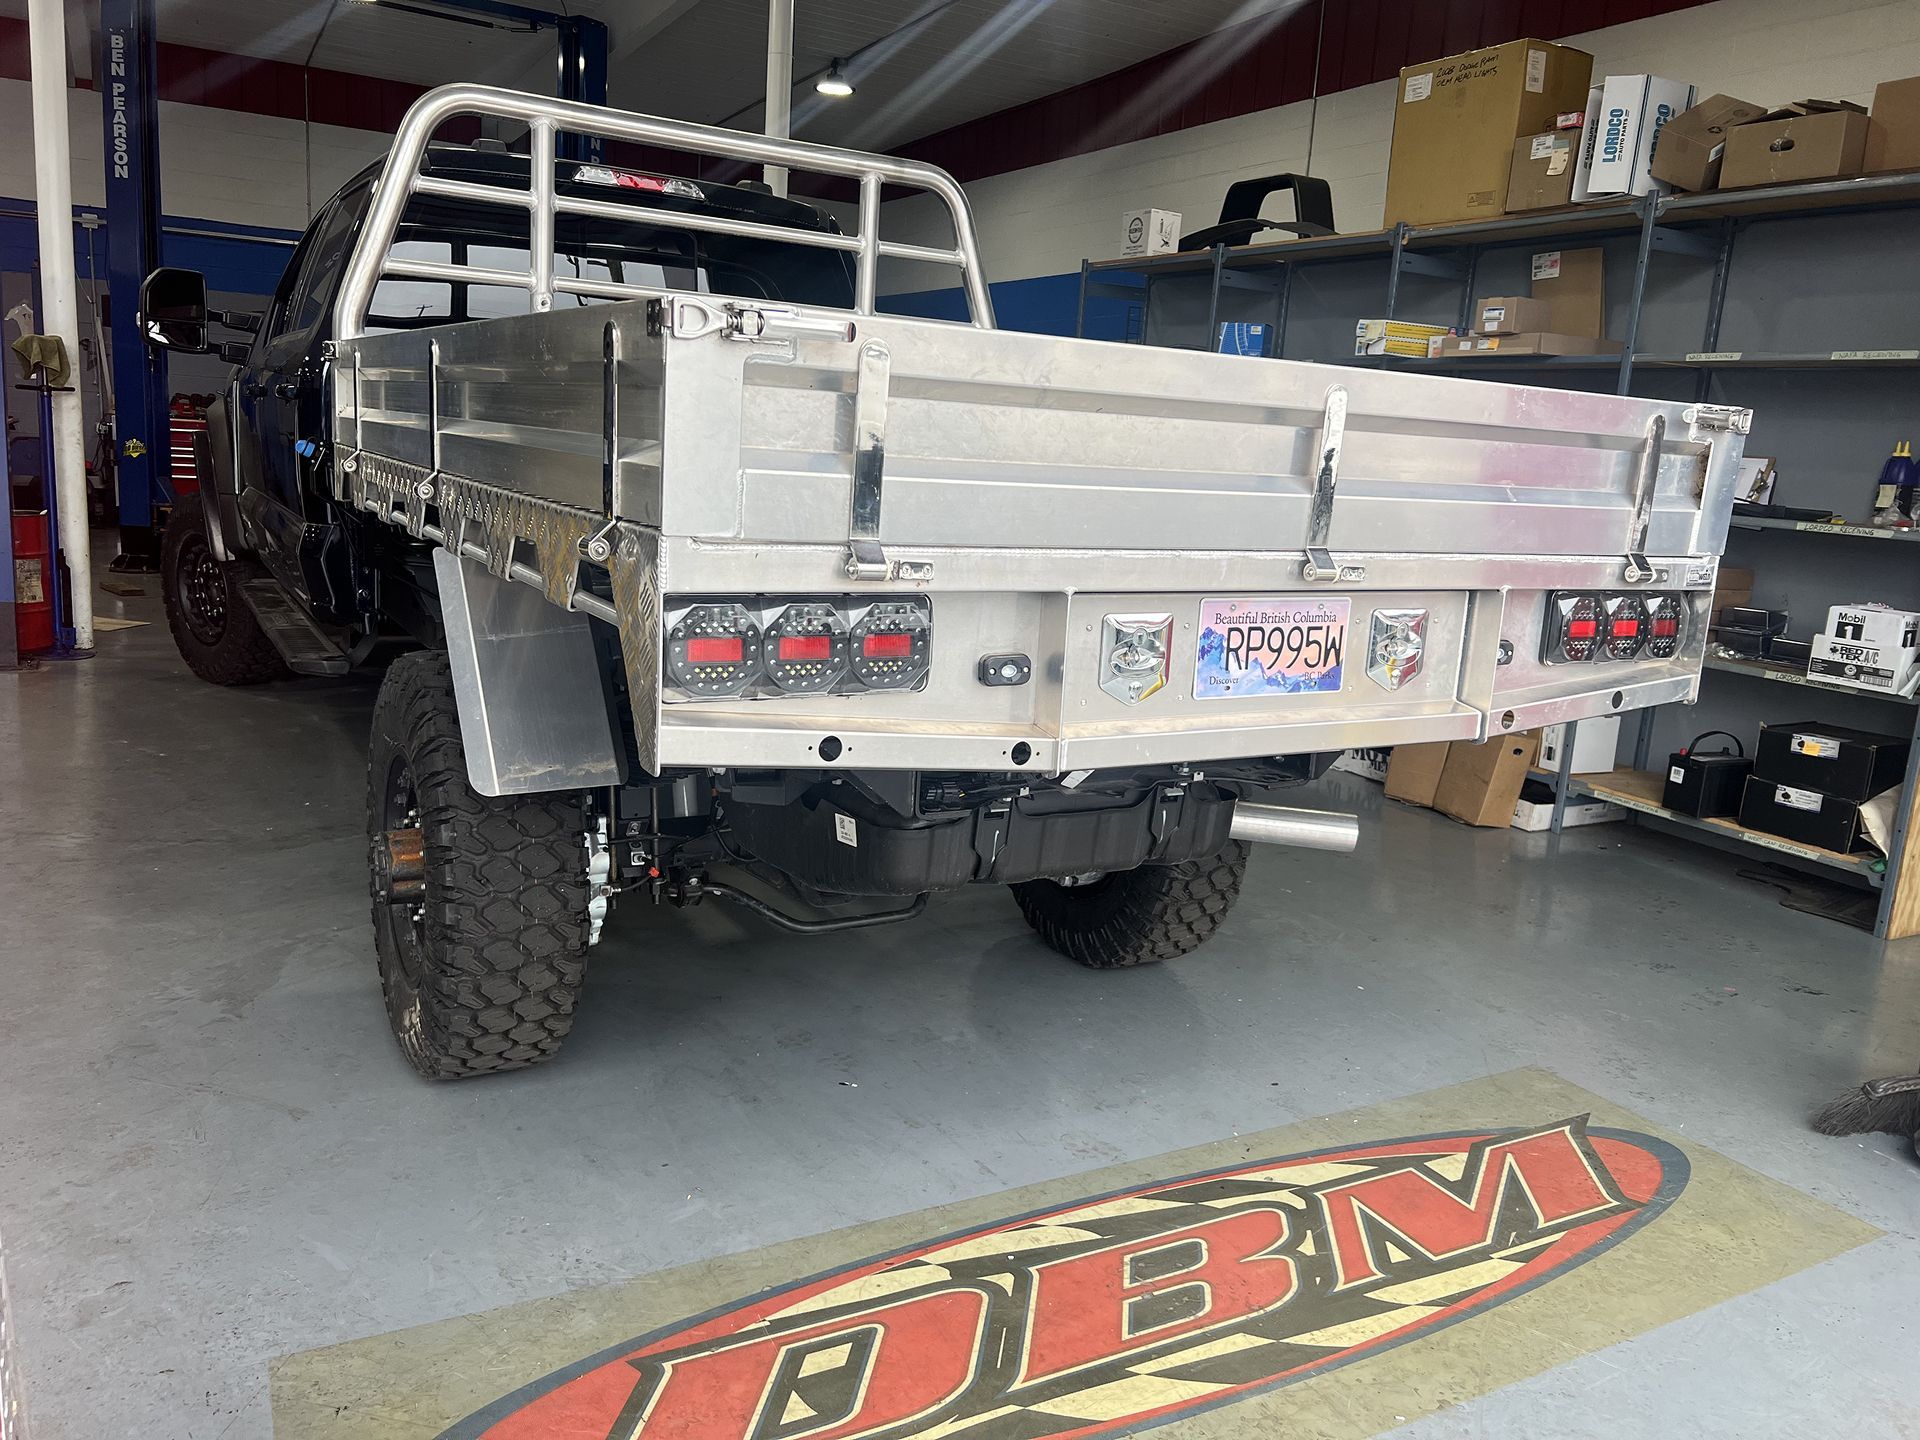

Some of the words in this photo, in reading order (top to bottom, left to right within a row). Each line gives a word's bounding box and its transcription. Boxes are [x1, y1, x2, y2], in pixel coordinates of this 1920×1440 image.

[110, 34, 126, 77] BEN
[112, 82, 129, 179] PEARSON
[1621, 118, 1629, 134] PARTS
[1587, 126, 1595, 142] AUTO
[1602, 108, 1624, 163] LORDCO
[1585, 142, 1593, 161] PARTS
[1804, 524, 1833, 532] LORDCO
[1840, 526, 1875, 536] RECEIVING
[1215, 611, 1258, 625] Beautiful
[1259, 611, 1291, 625] British
[1293, 611, 1337, 623] Columbia
[1838, 612, 1867, 624] Mobil
[1225, 625, 1344, 671] RP995W
[1840, 646, 1864, 656] RED
[1840, 652, 1862, 662] TEK
[1209, 675, 1239, 686] Discover
[1304, 671, 1314, 680] BC
[1317, 670, 1335, 680] Parks
[1775, 672, 1801, 683] LORDCO
[625, 1118, 1635, 1440] DBM
